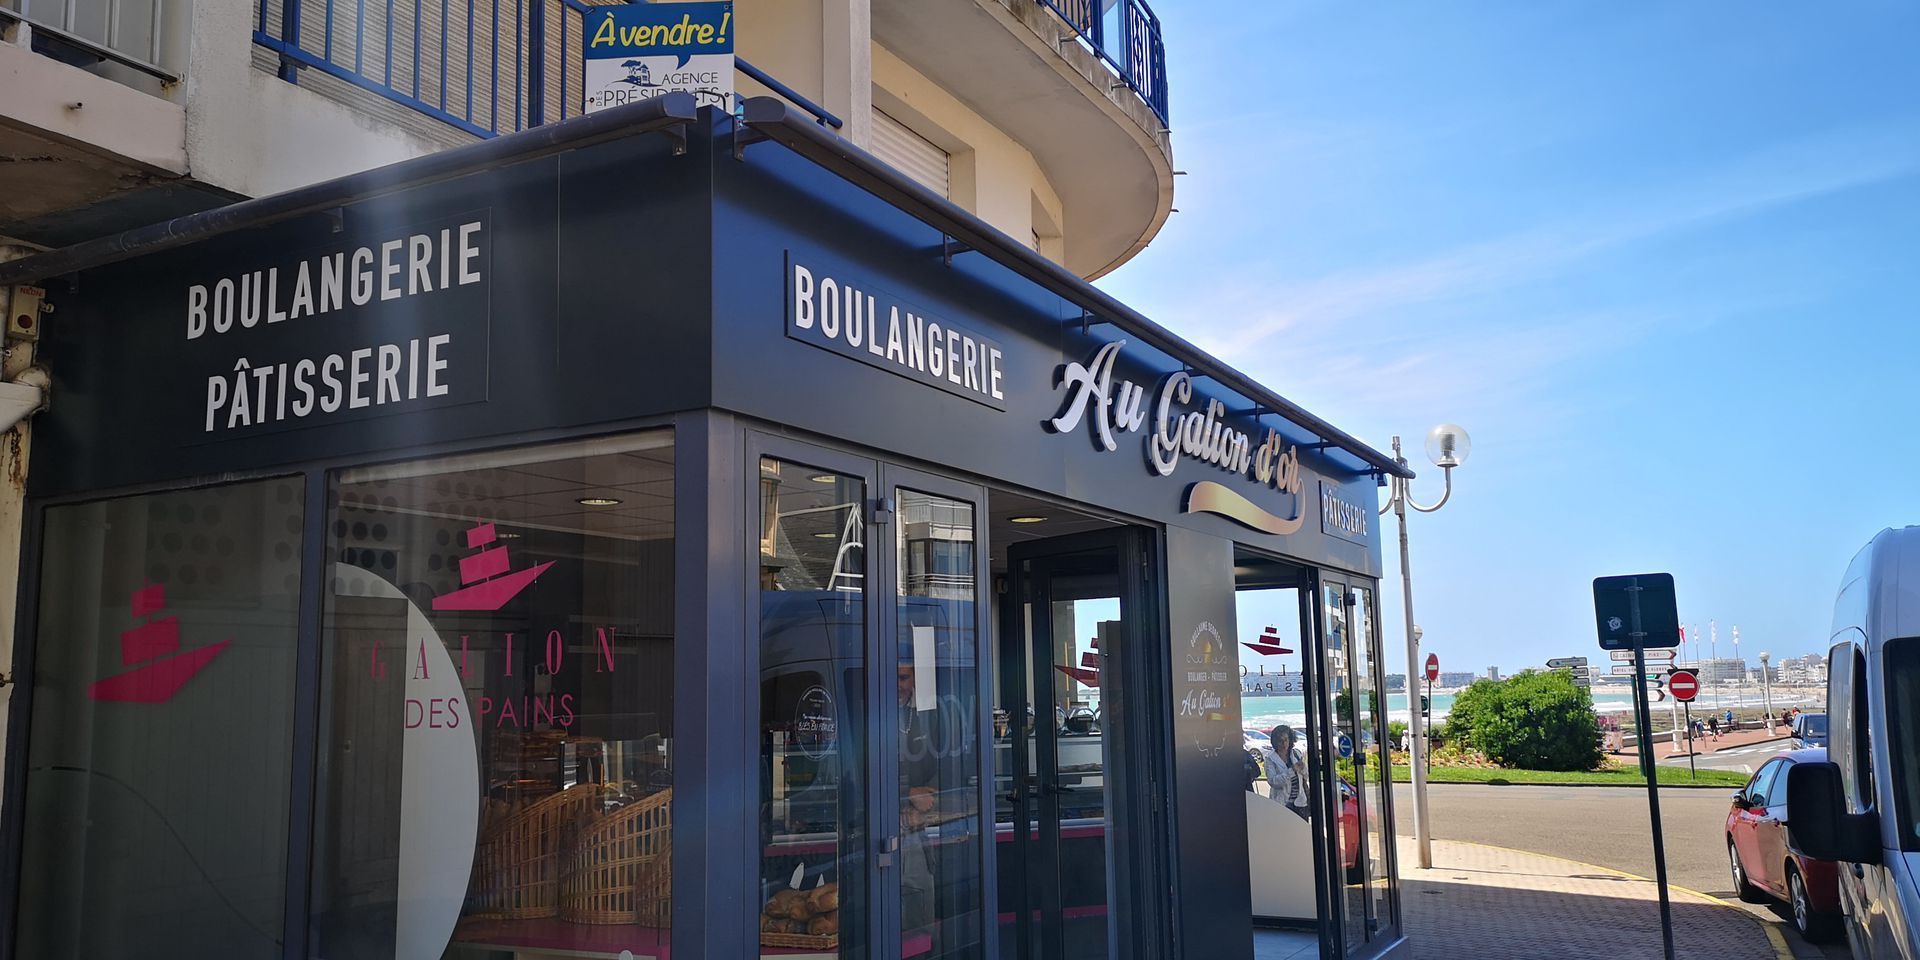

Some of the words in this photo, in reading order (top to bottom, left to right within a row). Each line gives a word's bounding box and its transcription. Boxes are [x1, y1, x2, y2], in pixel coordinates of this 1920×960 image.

[591, 12, 616, 48] À
[662, 72, 719, 85] AGENCE
[186, 221, 482, 340] BOULANGERIE
[794, 264, 1004, 400] BOULANGERIE
[205, 333, 451, 432] PÂTISSERIE
[1052, 339, 1145, 452] Au
[1151, 371, 1251, 477] Galion
[1254, 427, 1301, 495] d'or
[1323, 489, 1368, 537] PÂTISSERIE
[370, 626, 617, 681] GALION
[405, 698, 460, 729] DES
[477, 694, 576, 729] PAINS
